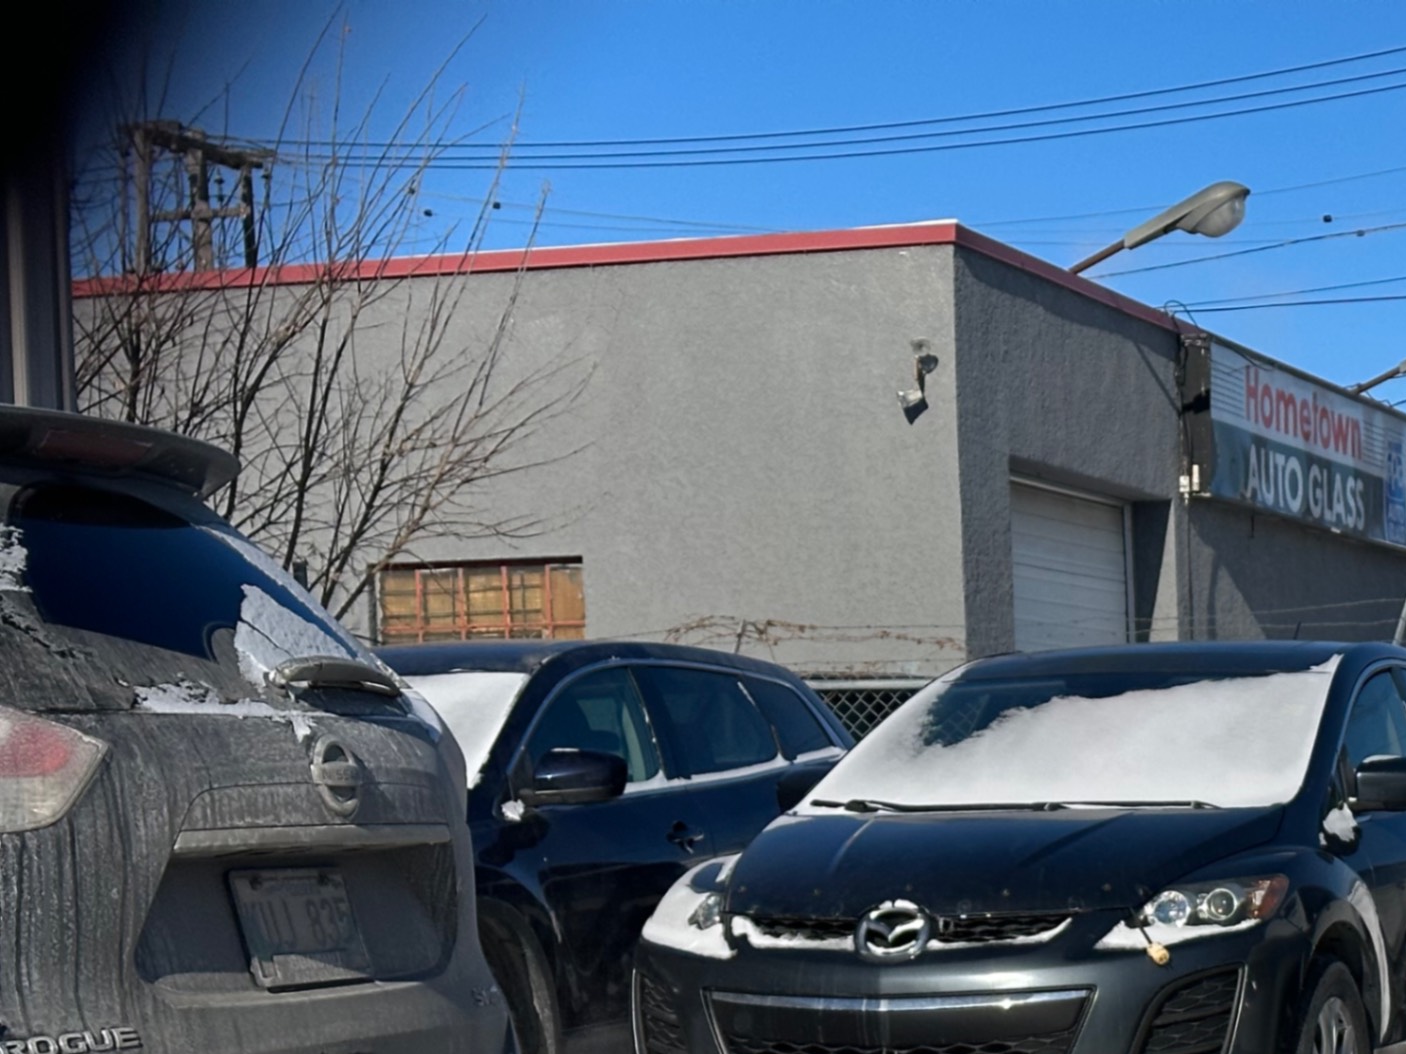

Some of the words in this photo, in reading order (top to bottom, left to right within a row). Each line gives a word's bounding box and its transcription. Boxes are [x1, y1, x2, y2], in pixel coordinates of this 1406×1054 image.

[1243, 365, 1364, 462] Hometown
[1243, 444, 1304, 513] AUTO
[1308, 463, 1366, 531] GLASS
